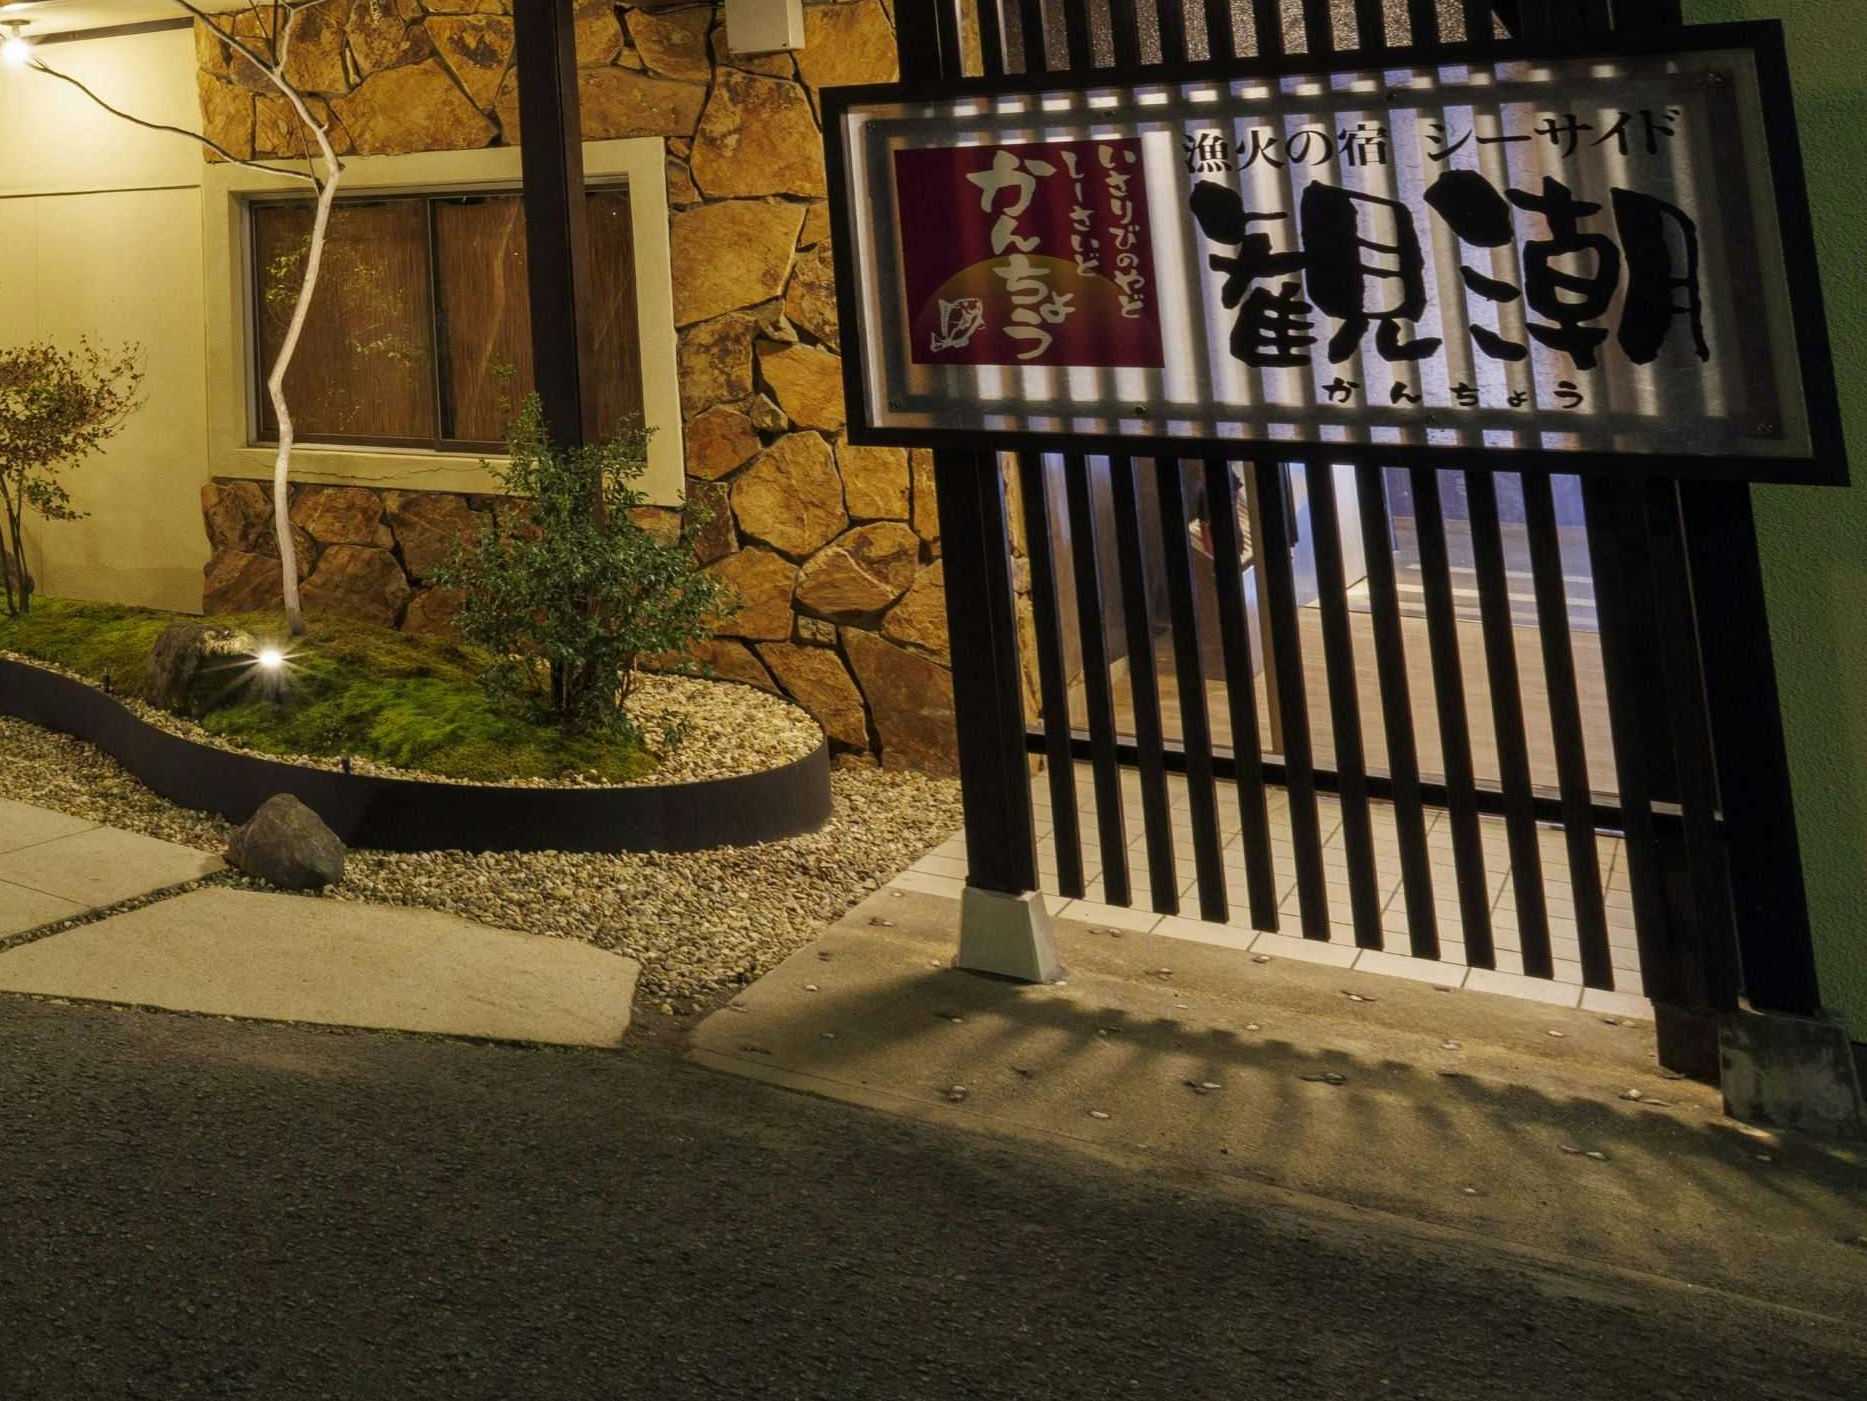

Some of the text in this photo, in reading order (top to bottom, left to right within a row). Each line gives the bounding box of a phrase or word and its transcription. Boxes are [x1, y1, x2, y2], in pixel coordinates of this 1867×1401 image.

[1183, 108, 1681, 174] 漁火の宿 シーサイド
[965, 149, 1077, 360] かんちょう
[1097, 144, 1145, 319] いさりびのやど
[1189, 169, 1710, 371] 観潮
[1321, 376, 1584, 409] かんちょう
